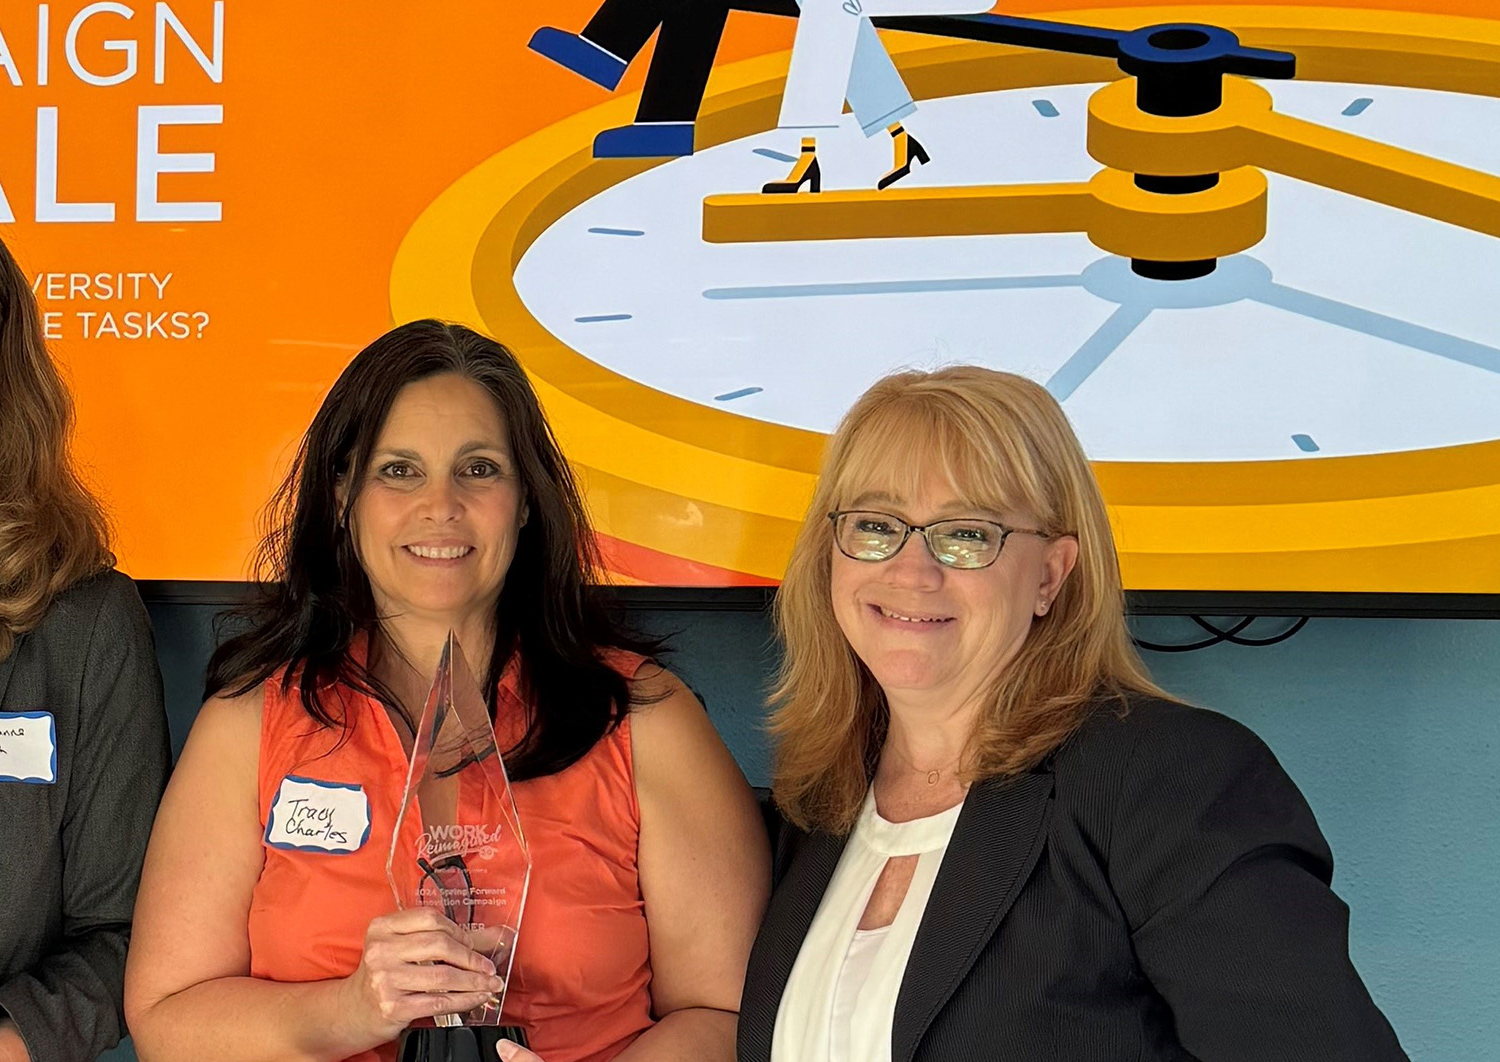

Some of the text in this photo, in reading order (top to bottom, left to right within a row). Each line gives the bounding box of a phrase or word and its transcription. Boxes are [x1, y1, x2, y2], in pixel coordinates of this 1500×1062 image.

[76, 311, 210, 339] TASKS?
[287, 798, 336, 829] Tracy
[285, 817, 348, 843] Charles
[429, 824, 488, 840] WORK
[469, 887, 506, 895] Forward
